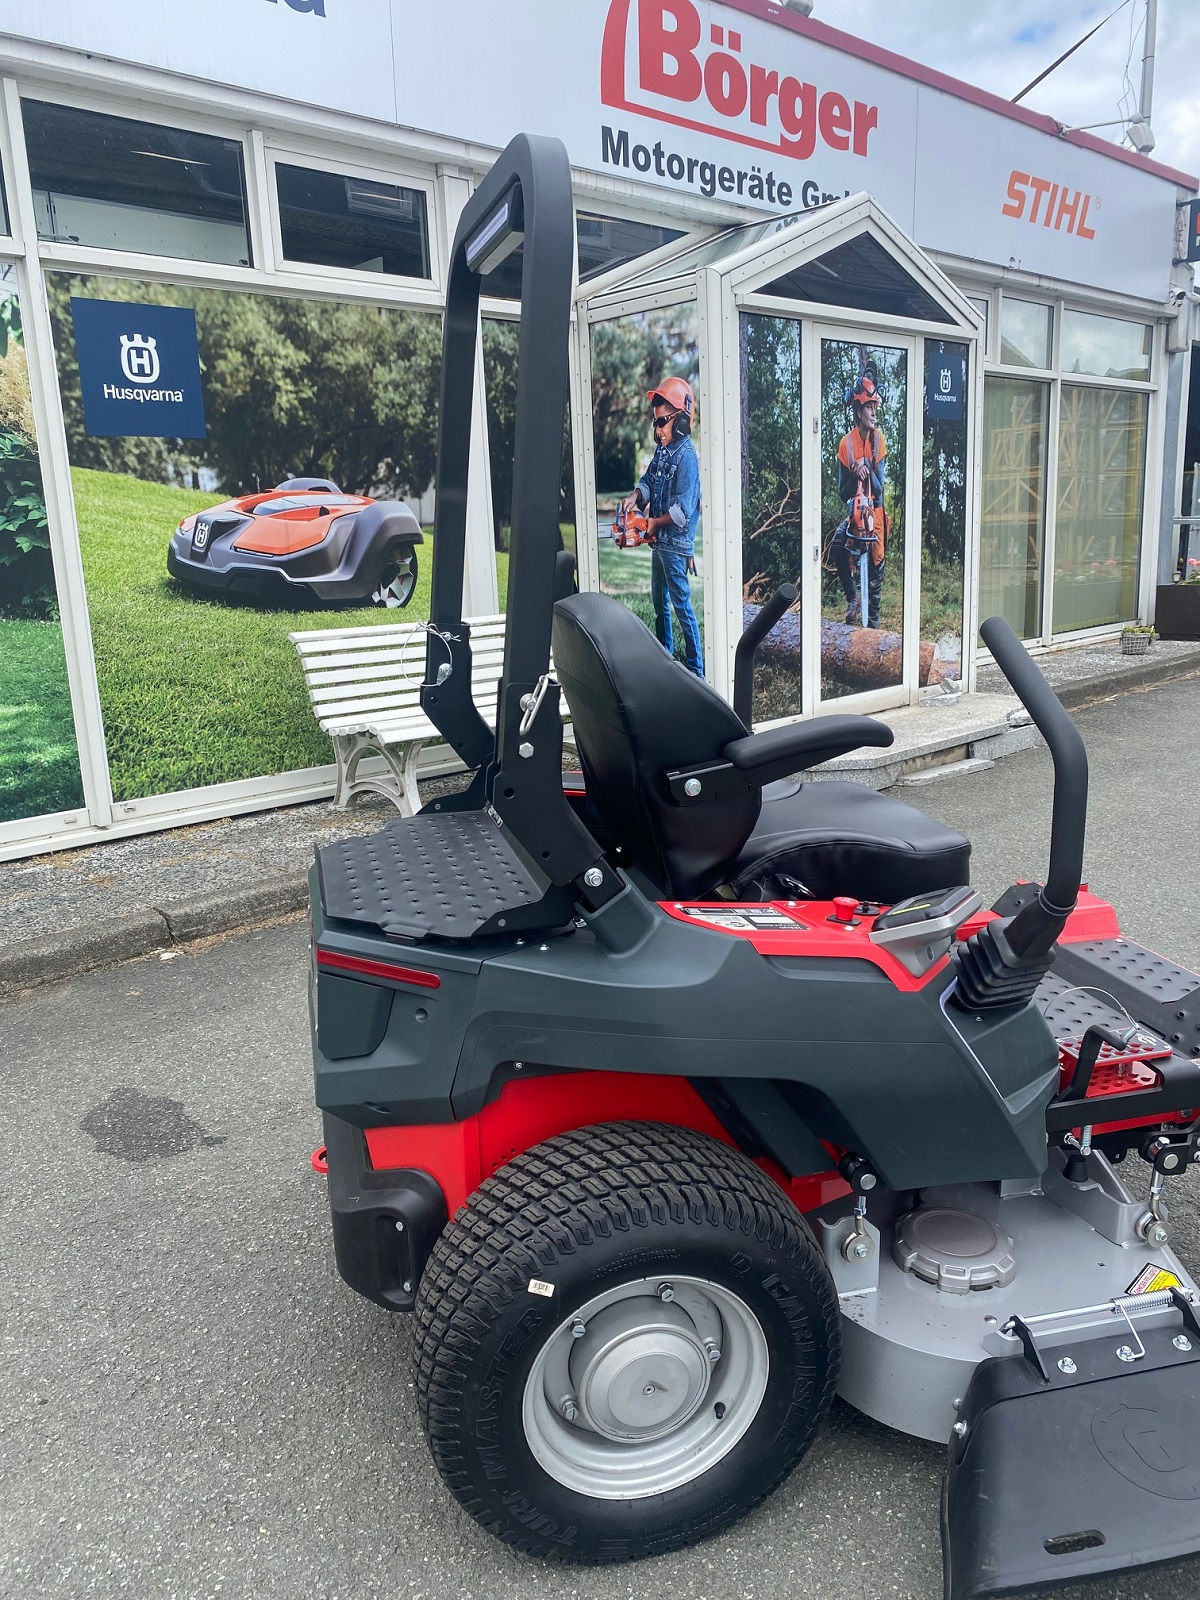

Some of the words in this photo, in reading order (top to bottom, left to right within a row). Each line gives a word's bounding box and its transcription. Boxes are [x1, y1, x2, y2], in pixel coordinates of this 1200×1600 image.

[637, 0, 878, 160] Börger
[601, 125, 793, 206] Motorgeräte
[1002, 170, 1096, 240] STIHL
[103, 384, 184, 403] Husqvarna
[934, 392, 957, 403] Husqvarna
